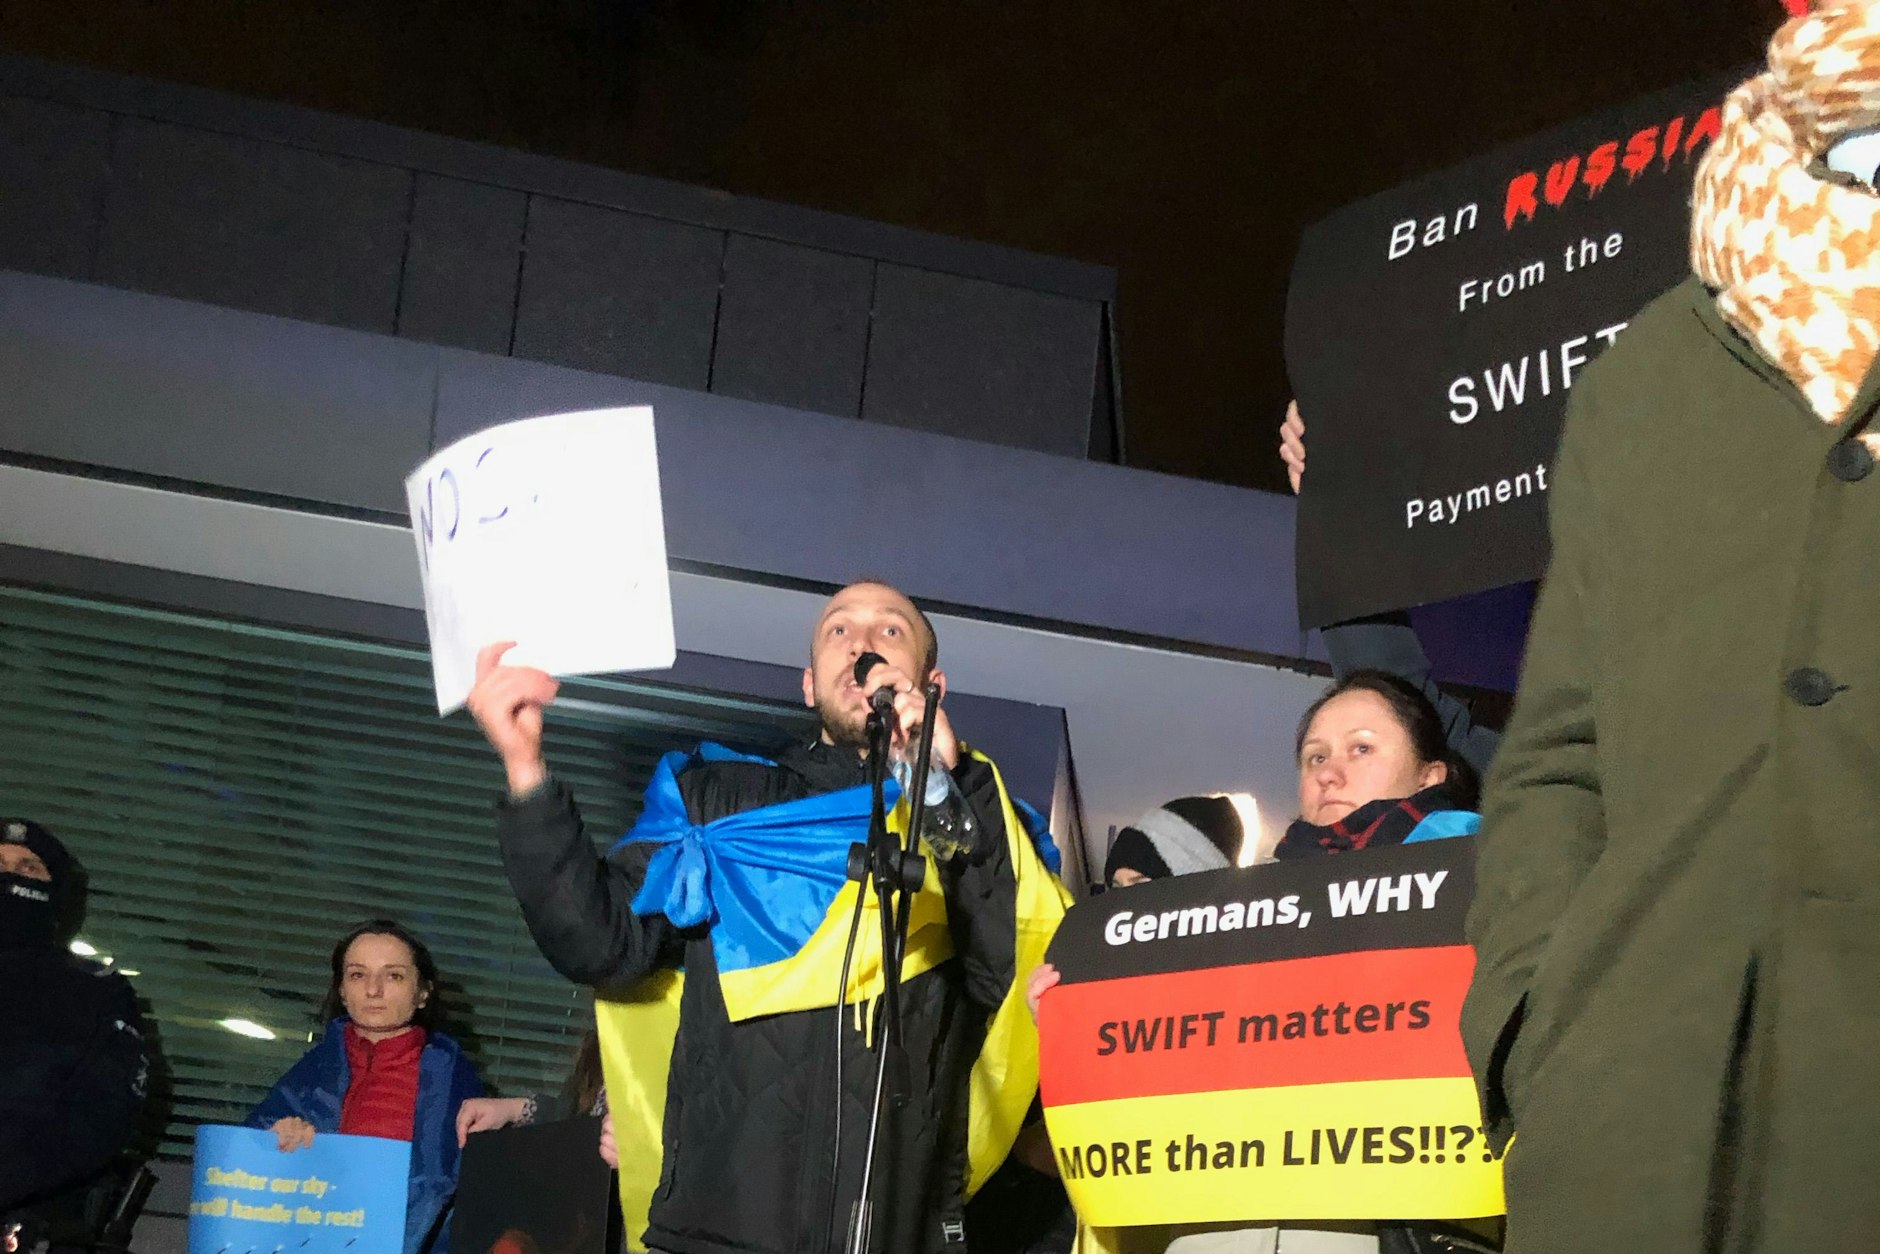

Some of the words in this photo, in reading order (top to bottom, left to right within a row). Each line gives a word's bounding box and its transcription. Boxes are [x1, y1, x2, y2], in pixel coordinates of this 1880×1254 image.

[1388, 202, 1479, 261] Ban
[1459, 260, 1545, 312] From
[1564, 231, 1623, 273] the
[1406, 464, 1548, 528] Payment
[1104, 893, 1312, 946] Germans,
[1327, 870, 1449, 918] WHY
[1097, 1011, 1224, 1056] SWIFT
[1237, 1000, 1431, 1044] matters
[1061, 1139, 1152, 1181] MORE
[1165, 1134, 1266, 1172] than
